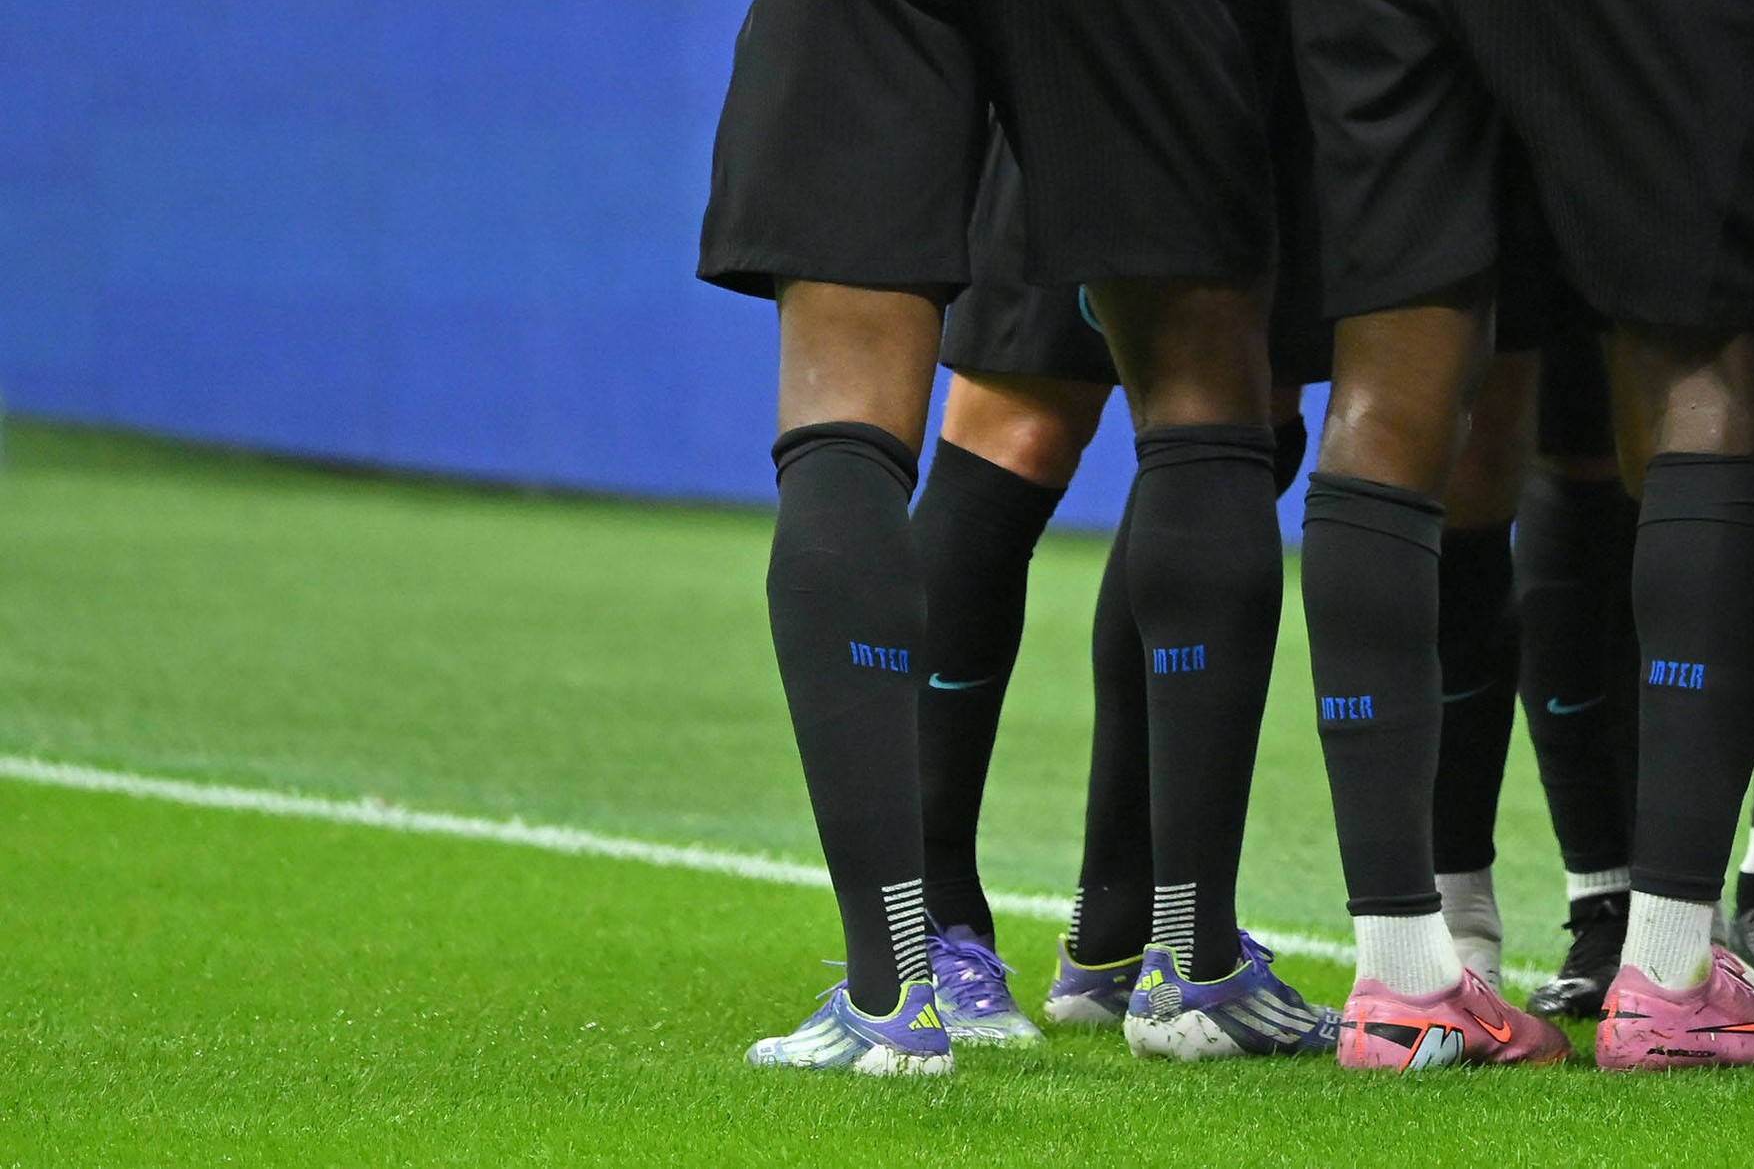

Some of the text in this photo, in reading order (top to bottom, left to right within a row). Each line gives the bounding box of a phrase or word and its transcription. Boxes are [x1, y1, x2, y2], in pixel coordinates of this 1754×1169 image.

[850, 641, 908, 674] INTER
[1153, 645, 1205, 674] INTER
[1648, 660, 1705, 690] INTER
[1321, 696, 1374, 720] INTER
